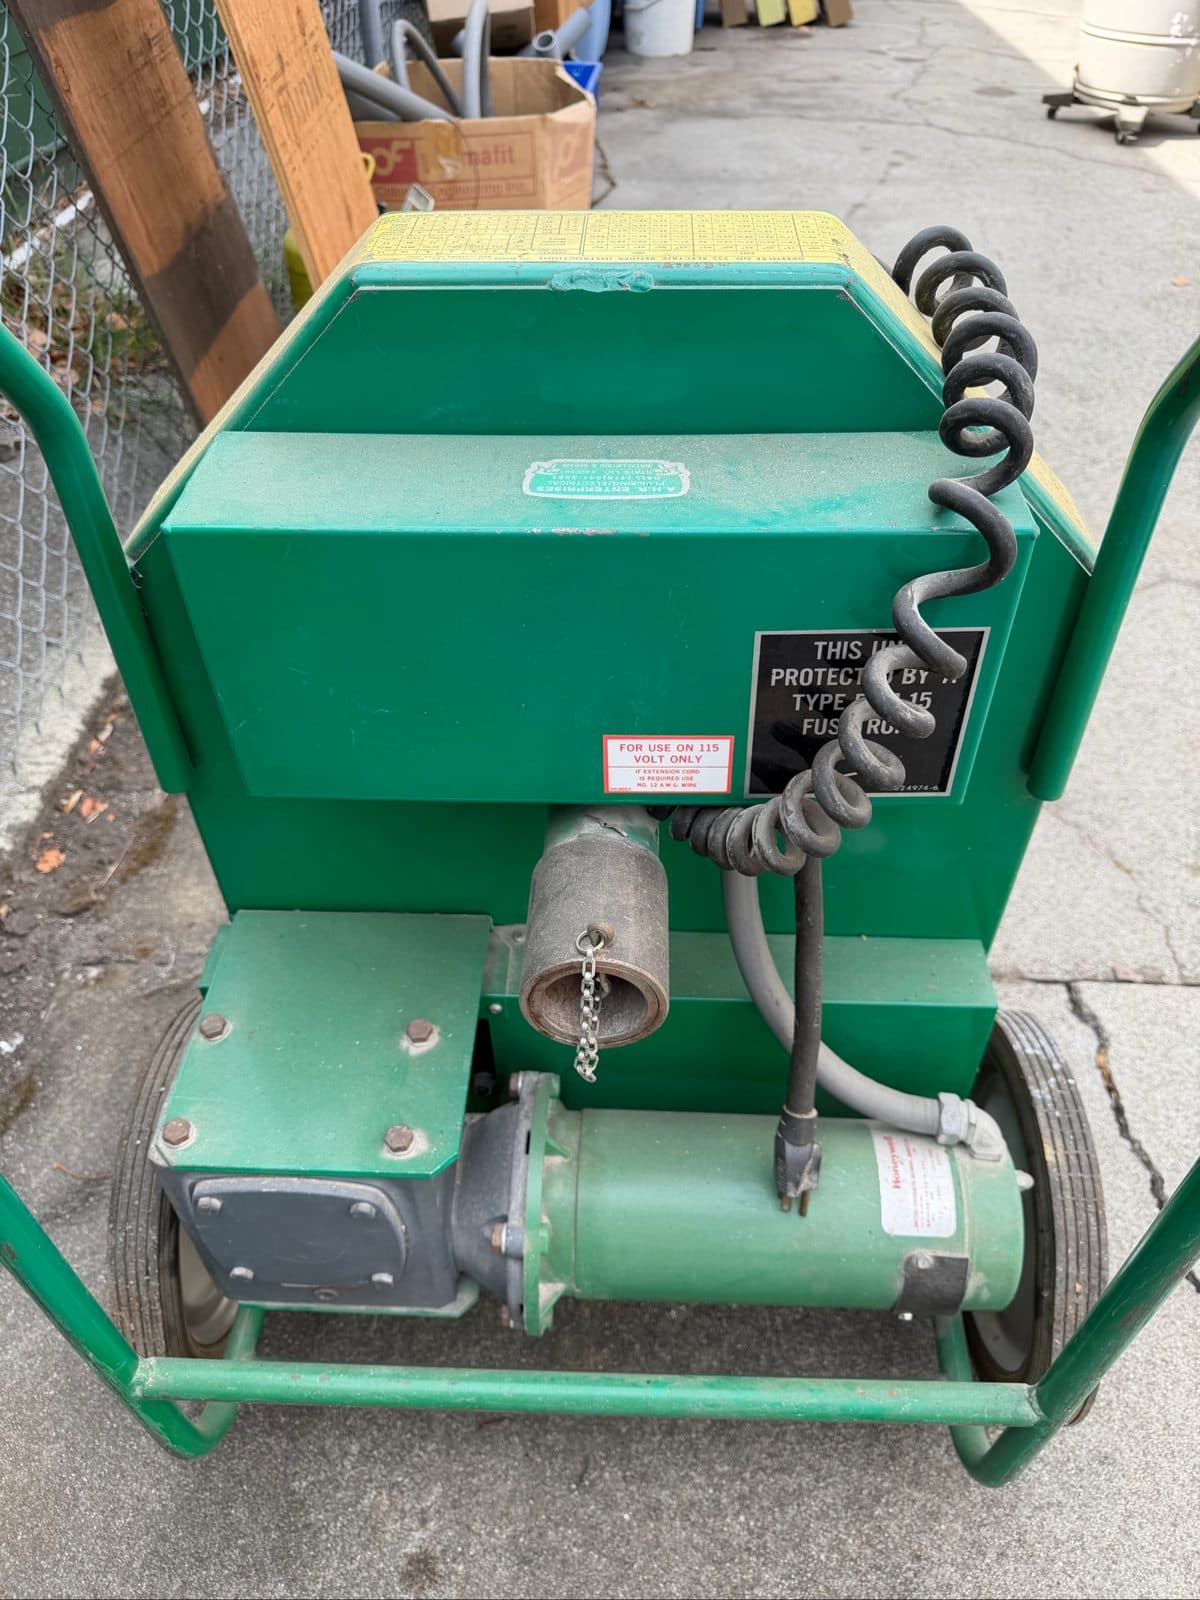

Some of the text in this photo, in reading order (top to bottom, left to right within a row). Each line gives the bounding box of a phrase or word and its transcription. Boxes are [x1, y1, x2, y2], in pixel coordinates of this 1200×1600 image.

[814, 640, 863, 660] THIS
[901, 668, 930, 685] BY
[792, 693, 847, 712] TYPE
[909, 691, 932, 710] 15
[620, 744, 719, 752] FOR USE ON 115
[634, 755, 702, 763] VOLT ONLY
